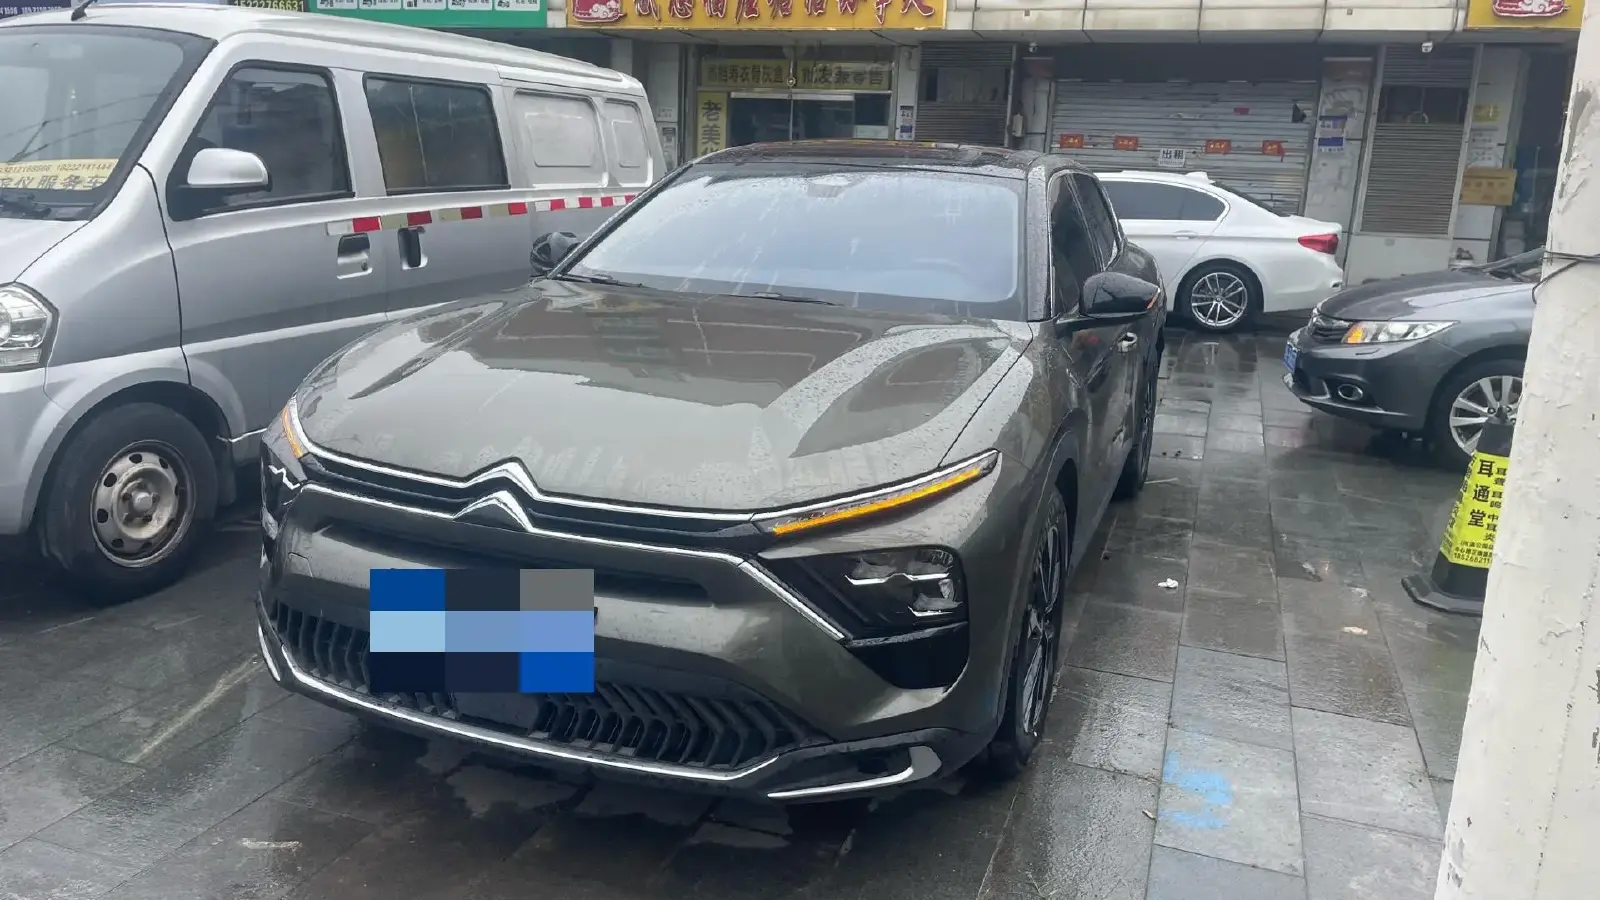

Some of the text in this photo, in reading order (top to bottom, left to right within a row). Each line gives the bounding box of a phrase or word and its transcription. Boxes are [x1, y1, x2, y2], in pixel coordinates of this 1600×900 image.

[1162, 149, 1184, 160] 出租
[1467, 459, 1495, 528] 耳通堂
